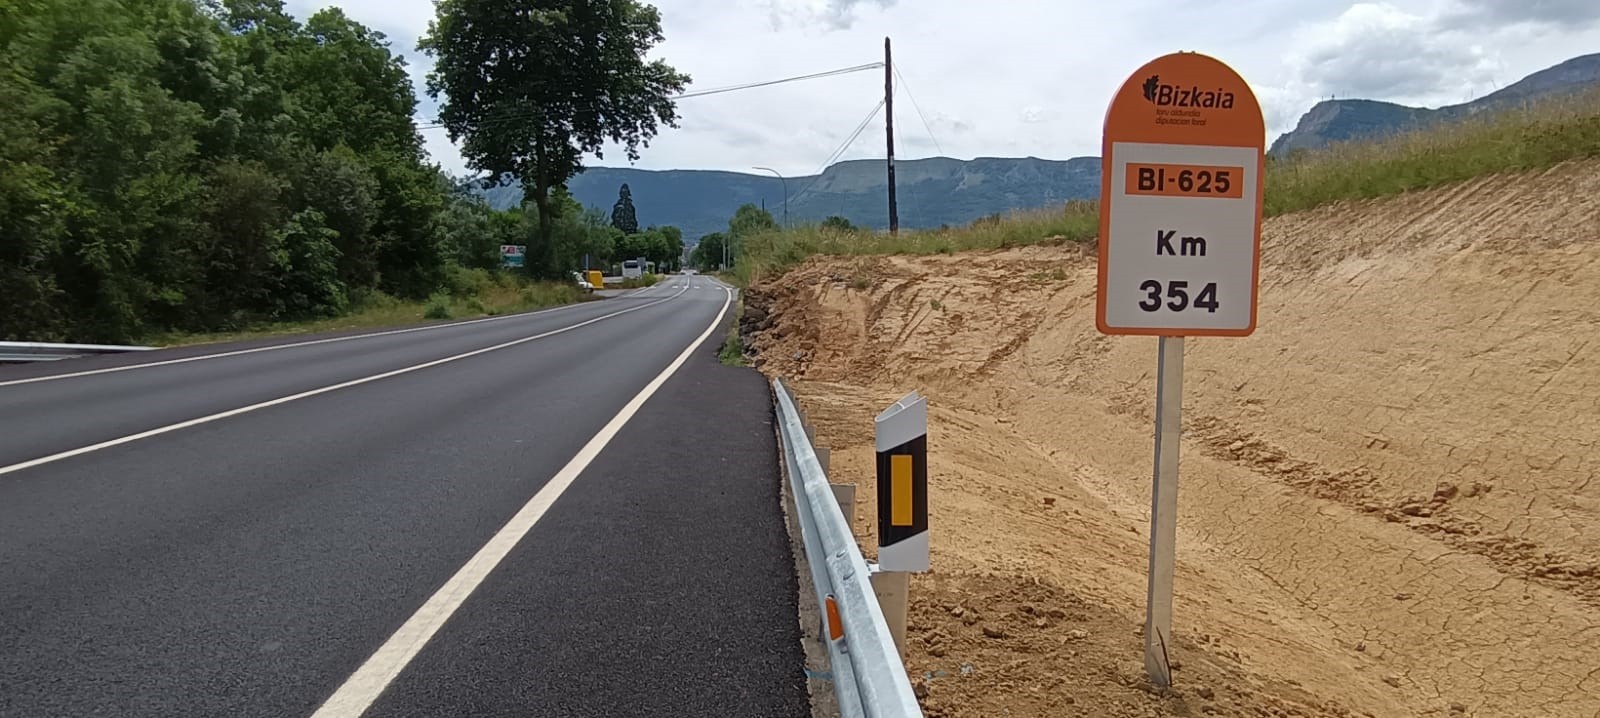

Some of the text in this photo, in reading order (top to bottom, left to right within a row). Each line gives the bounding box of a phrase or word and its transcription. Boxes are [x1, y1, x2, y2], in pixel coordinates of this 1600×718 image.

[1157, 84, 1234, 109] Bizkaia
[1138, 168, 1230, 193] BI-625
[1157, 230, 1206, 256] Km
[1139, 280, 1219, 313] 354
